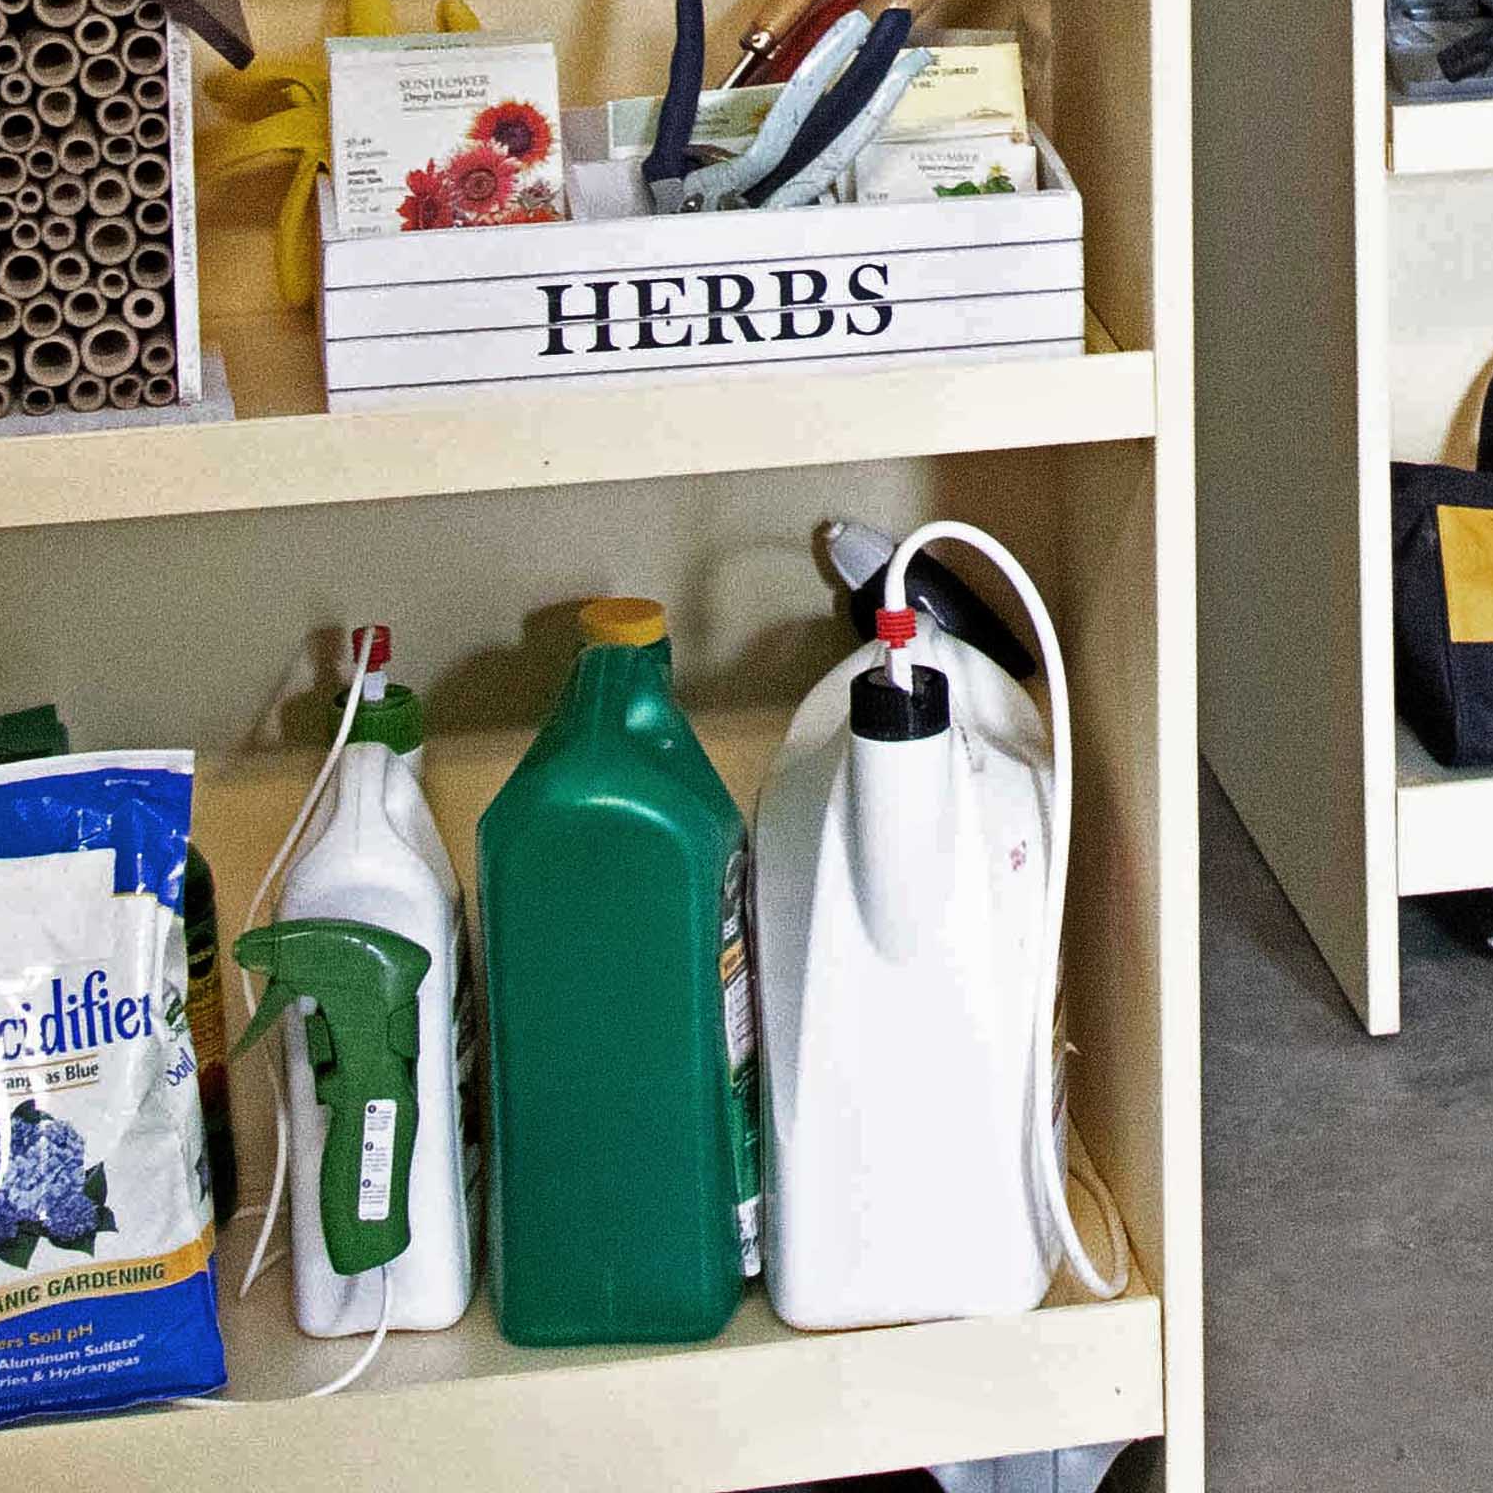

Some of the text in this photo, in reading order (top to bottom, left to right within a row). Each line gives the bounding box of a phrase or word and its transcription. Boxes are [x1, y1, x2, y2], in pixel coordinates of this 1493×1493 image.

[537, 264, 893, 356] HERBS
[65, 1063, 99, 1081] Blue
[47, 1262, 166, 1296] GARDENING
[28, 1329, 62, 1346] Soil
[67, 1321, 94, 1342] pH
[48, 1355, 141, 1379] Hydrangeas
